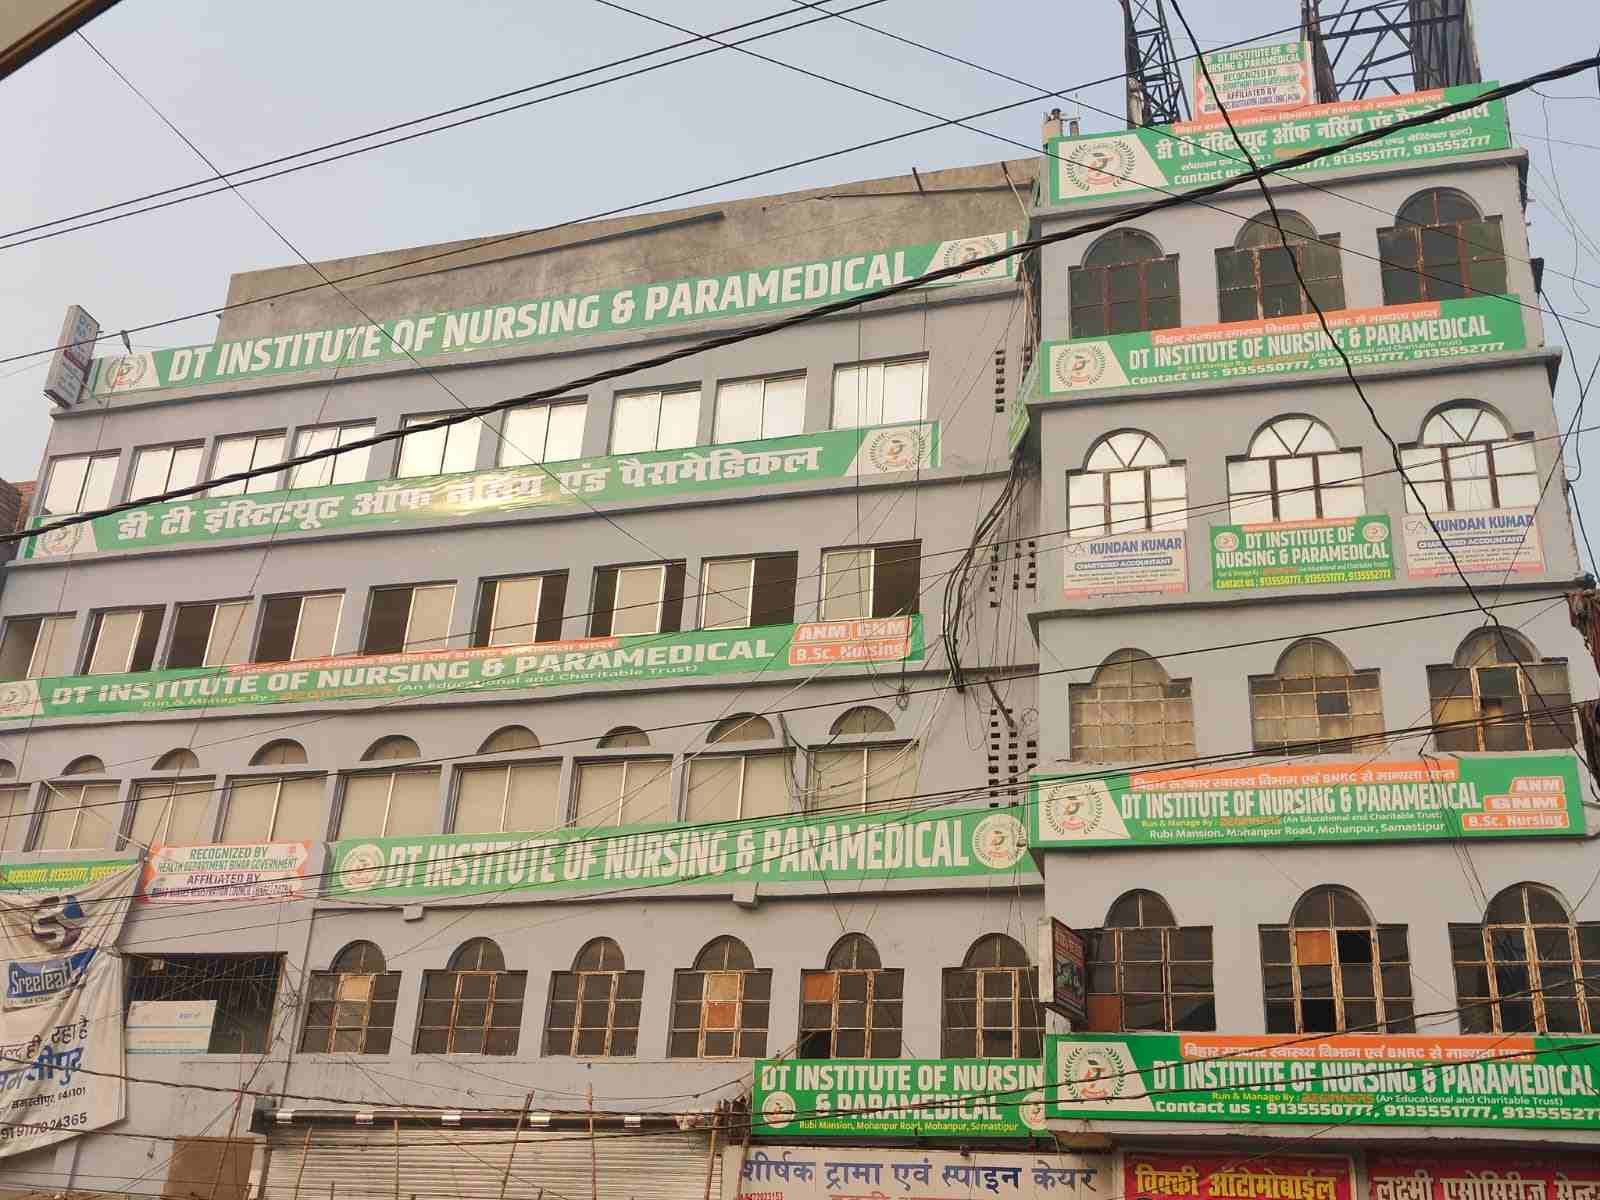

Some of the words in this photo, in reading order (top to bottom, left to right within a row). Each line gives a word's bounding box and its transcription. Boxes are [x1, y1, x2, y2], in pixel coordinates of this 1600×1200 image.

[168, 347, 213, 382] DT
[216, 324, 385, 375] INSTITUTE
[391, 317, 437, 353] OF
[441, 295, 600, 349] NURSING
[610, 290, 636, 325] &
[645, 251, 913, 321] PARAMEDICAL
[1129, 348, 1150, 370] DT
[1154, 341, 1239, 369] INSTITUTE
[1242, 337, 1264, 358] OF
[1268, 329, 1345, 357] NURSING
[1349, 326, 1361, 348] &
[1365, 315, 1491, 346] PARAMEDICAL
[1131, 371, 1187, 385] Contact
[1190, 369, 1210, 379] us
[118, 511, 154, 540] डी
[160, 505, 198, 535] टी
[559, 464, 611, 495] एंड
[616, 446, 824, 487] पैरामेडिकल
[1432, 516, 1486, 532] KUNDAN
[1488, 514, 1534, 528] KUMAR
[1089, 540, 1140, 555] KUNDAN
[1141, 537, 1182, 551] KUMAR
[1245, 533, 1264, 549] DT
[1266, 527, 1336, 548] INSTITUTE
[1338, 526, 1356, 543] OF
[1215, 550, 1276, 569] NURSING
[1292, 542, 1390, 564] PARAMEDICAL
[50, 687, 96, 704] DT
[97, 674, 261, 701] INSTITUTE
[267, 671, 312, 691] OF
[316, 660, 470, 690] NURSING
[481, 657, 504, 678] &
[515, 638, 776, 674] PARAMEDICAL
[1121, 793, 1141, 819] DT
[1144, 789, 1229, 819] INSTITUTE
[1233, 790, 1256, 817] OF
[1259, 785, 1336, 816] NURSING
[1339, 784, 1351, 812] &
[1355, 781, 1482, 811] PARAMEDICAL
[1150, 828, 1174, 839] Rubi
[190, 847, 251, 860] RECOGNIZED
[254, 846, 270, 858] BY
[385, 846, 423, 888] DT
[424, 838, 560, 888] INSTITUTE
[562, 836, 597, 880] OF
[603, 827, 729, 879] NURSING
[761, 818, 970, 874] PARAMEDICAL
[186, 873, 246, 885] AFFILIATED
[51, 1025, 76, 1045] रहा
[79, 1015, 89, 1040] है
[761, 1065, 790, 1091] DT
[795, 1065, 912, 1091] INSTITUTE
[918, 1065, 948, 1091] OF
[953, 1064, 1044, 1091] NURSIN
[1153, 1060, 1179, 1090] DT
[1183, 1060, 1287, 1092] INSTITUTE
[1290, 1061, 1315, 1092] OF
[1321, 1062, 1417, 1093] NURSING
[1422, 1064, 1437, 1093] &
[1443, 1063, 1600, 1096] PARAMEDICAL
[838, 1093, 1002, 1120] PARAMEDICAL
[1155, 1101, 1225, 1114] Contact
[1229, 1103, 1250, 1114] us
[1266, 1103, 1380, 1118] 9135550777,
[1384, 1106, 1498, 1121] 9135551777,
[1212, 1092, 1230, 1101] Run
[1242, 1093, 1281, 1103] Manage
[1376, 1094, 1393, 1104] (An
[1395, 1095, 1452, 1105] Educational
[1455, 1095, 1471, 1105] and
[1473, 1095, 1530, 1106] Charitable
[1532, 1096, 1563, 1107] Trust)
[740, 1151, 816, 1183] शीर्षक
[824, 1162, 883, 1189] ट्रामा
[891, 1157, 932, 1191] एवं
[941, 1165, 1022, 1195] स्पाइन
[1031, 1159, 1098, 1192] केयर
[1135, 1163, 1199, 1195] विक्की
